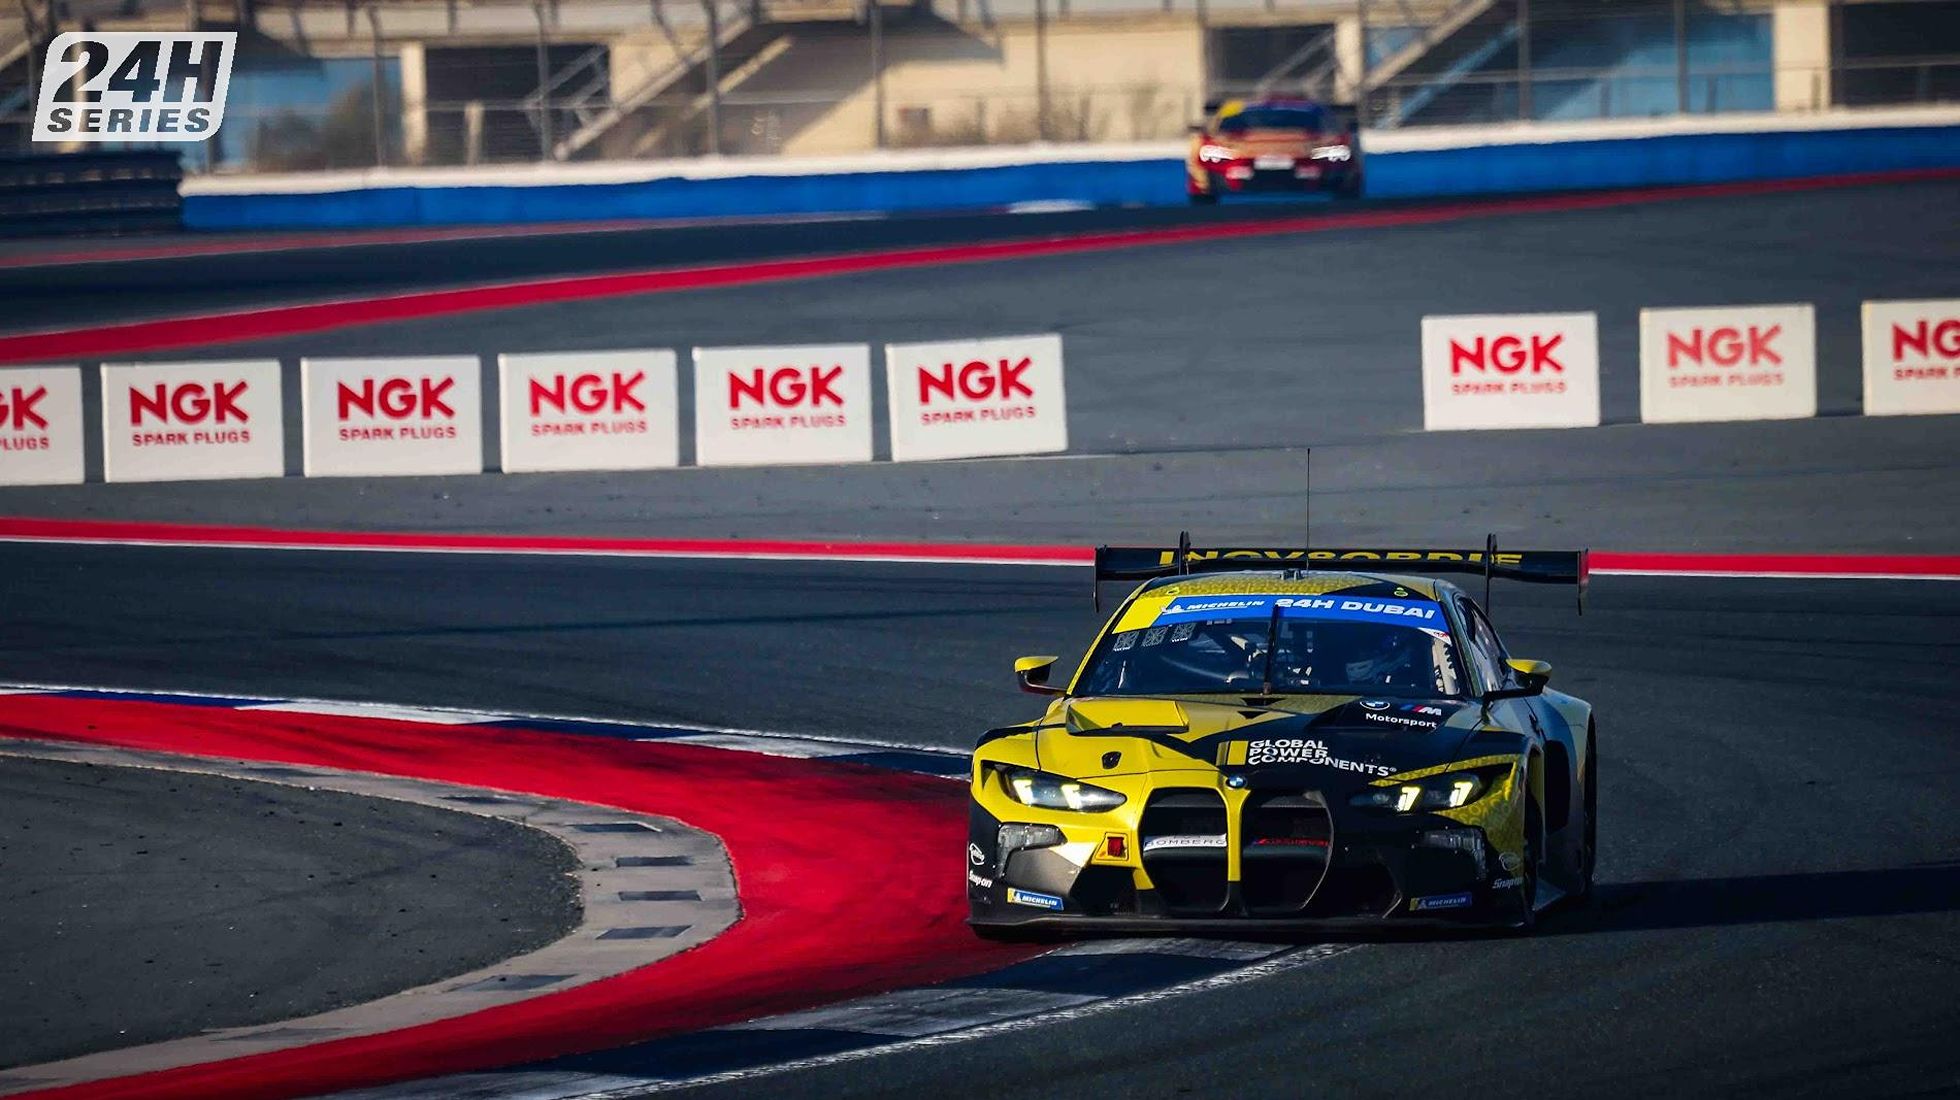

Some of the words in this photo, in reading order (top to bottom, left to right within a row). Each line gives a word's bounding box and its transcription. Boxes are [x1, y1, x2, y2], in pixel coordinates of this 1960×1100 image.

[1449, 332, 1565, 376] NGK
[1666, 324, 1783, 368] NGK
[917, 356, 1035, 406] NGK
[1894, 366, 1949, 380] SPARK
[528, 369, 647, 418] NGK
[727, 364, 844, 410] NGK
[128, 380, 250, 428] NGK
[337, 376, 456, 421] NGK
[0, 385, 49, 430] K
[921, 409, 975, 424] SPARK
[979, 406, 1035, 419] PLUGS
[532, 421, 586, 436] SPARK
[590, 419, 648, 435] PLUGS
[731, 415, 785, 429] SPARK
[789, 413, 846, 426] PLUGS
[133, 431, 188, 446] SPARK
[192, 429, 251, 443] PLUGS
[339, 425, 394, 440] SPARK
[399, 425, 457, 438] PLUGS
[1186, 600, 1265, 610] MICHELIN
[1275, 598, 1335, 609] 24H
[1340, 600, 1436, 619] DUBAI
[1365, 712, 1438, 728] Motorsport
[1249, 746, 1329, 758] POWER
[1250, 739, 1329, 750] GLOBAL
[1021, 895, 1058, 906] MICHELIN
